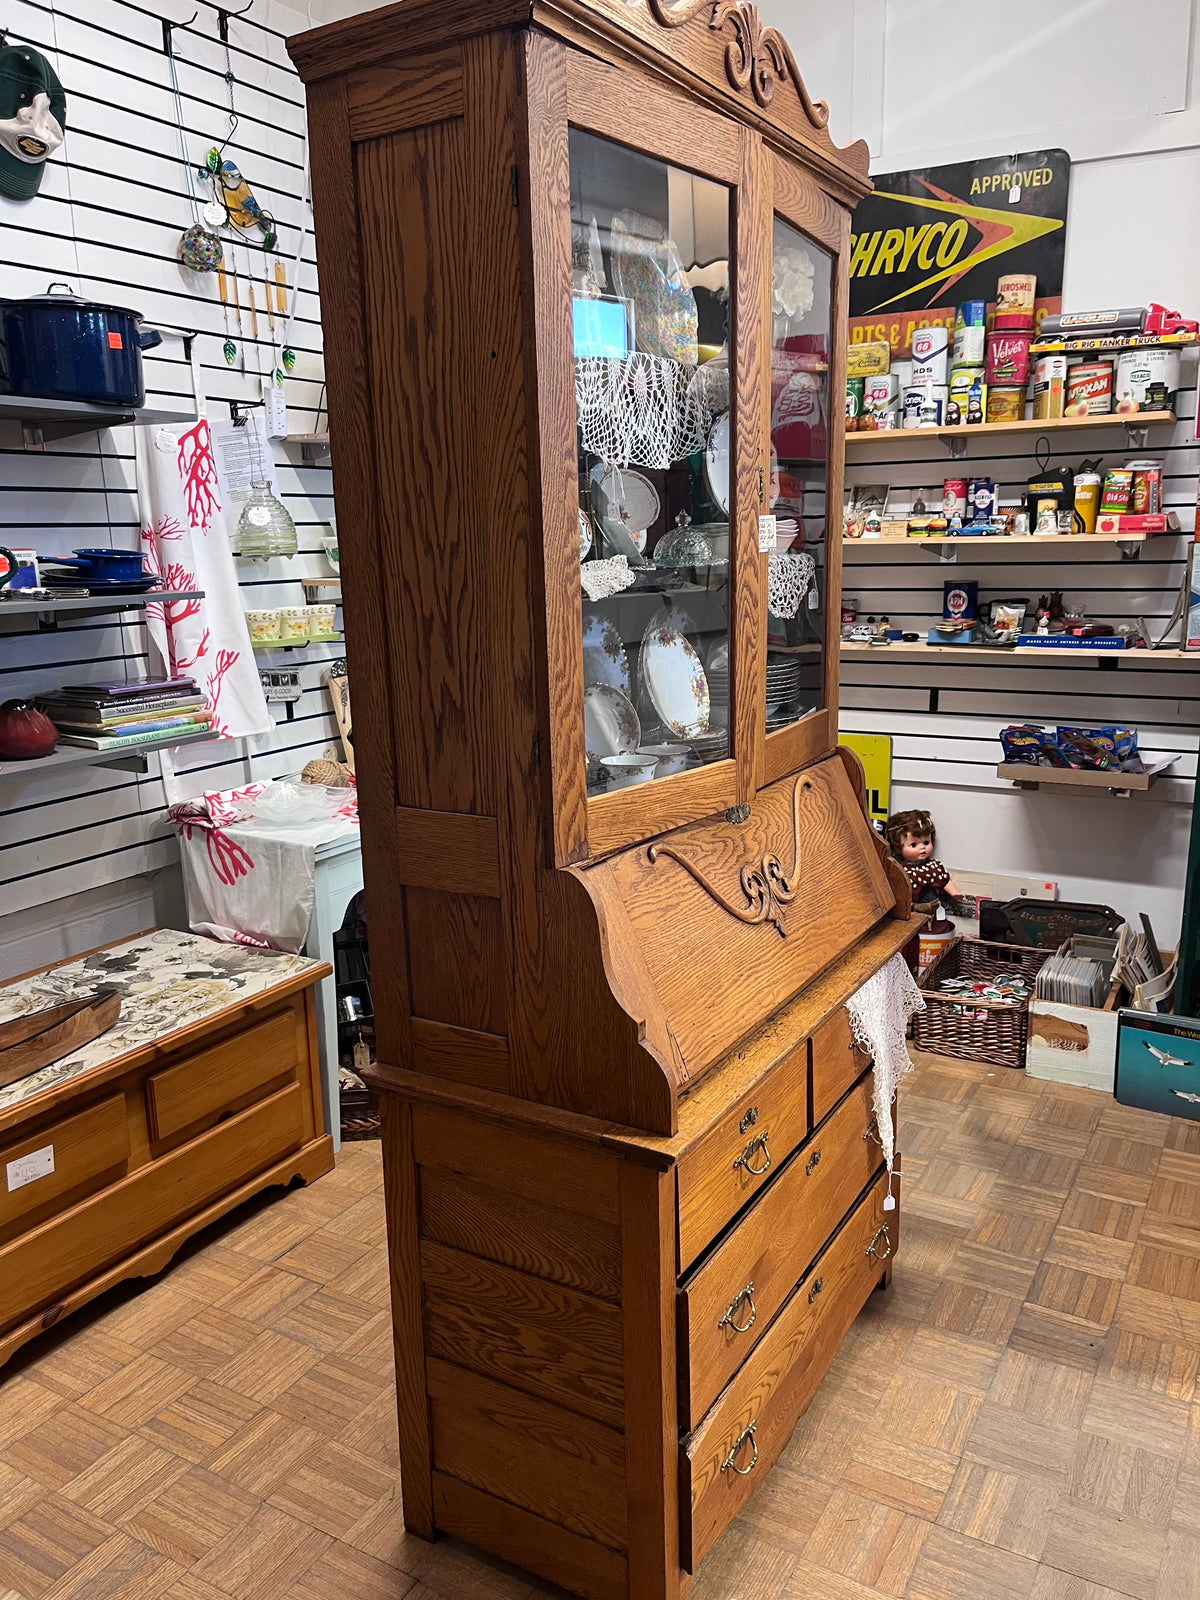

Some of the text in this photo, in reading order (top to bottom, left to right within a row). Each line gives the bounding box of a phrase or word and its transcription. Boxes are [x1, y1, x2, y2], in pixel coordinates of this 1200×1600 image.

[970, 168, 1053, 195] APPROVED
[849, 218, 969, 279] HRYCO
[1000, 282, 1033, 293] AEROSHELL
[849, 323, 886, 346] RTS
[916, 342, 929, 351] 66
[1064, 342, 1078, 350] BIG
[1099, 338, 1131, 347] TANKER
[1134, 336, 1161, 345] TRUCK
[992, 339, 1025, 366] Velvet
[913, 367, 933, 375] HDS
[873, 389, 886, 399] 66
[116, 700, 178, 714] Successful Houseplants
[1173, 1028, 1187, 1037] The
